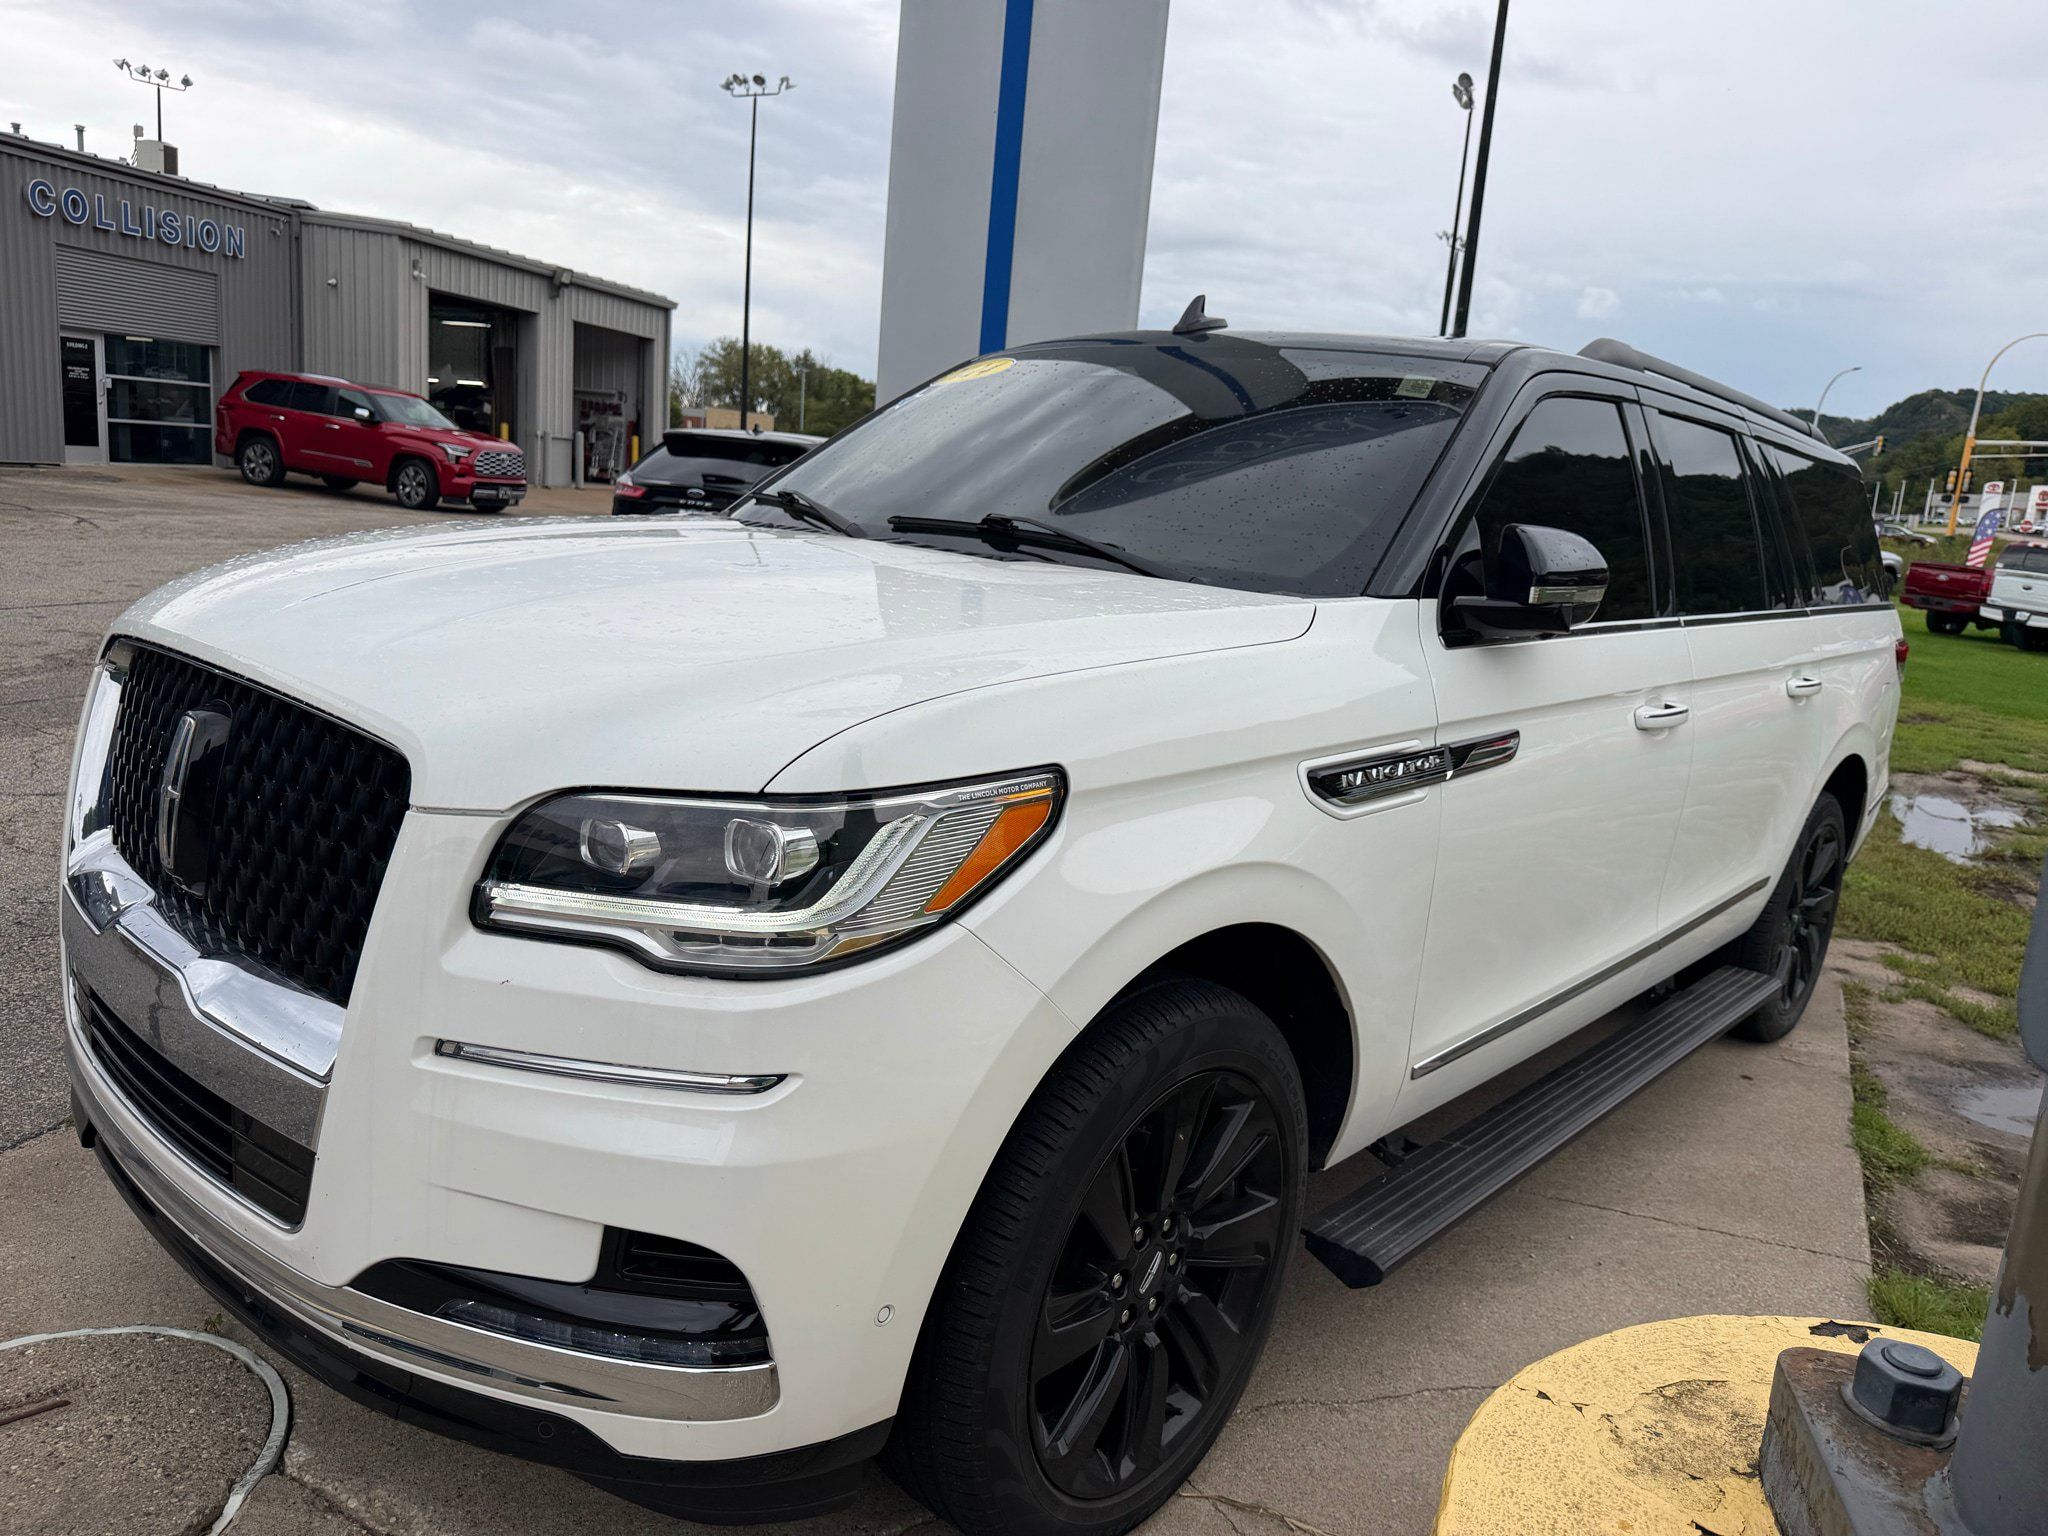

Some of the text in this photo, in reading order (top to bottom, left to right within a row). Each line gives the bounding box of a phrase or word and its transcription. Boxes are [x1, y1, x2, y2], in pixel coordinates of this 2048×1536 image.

[28, 178, 245, 258] COLLISION
[1341, 755, 1440, 787] NAVIGATOR
[971, 789, 998, 799] LINCOLN
[998, 785, 1020, 795] MOTOR
[1020, 780, 1047, 791] COMPANY
